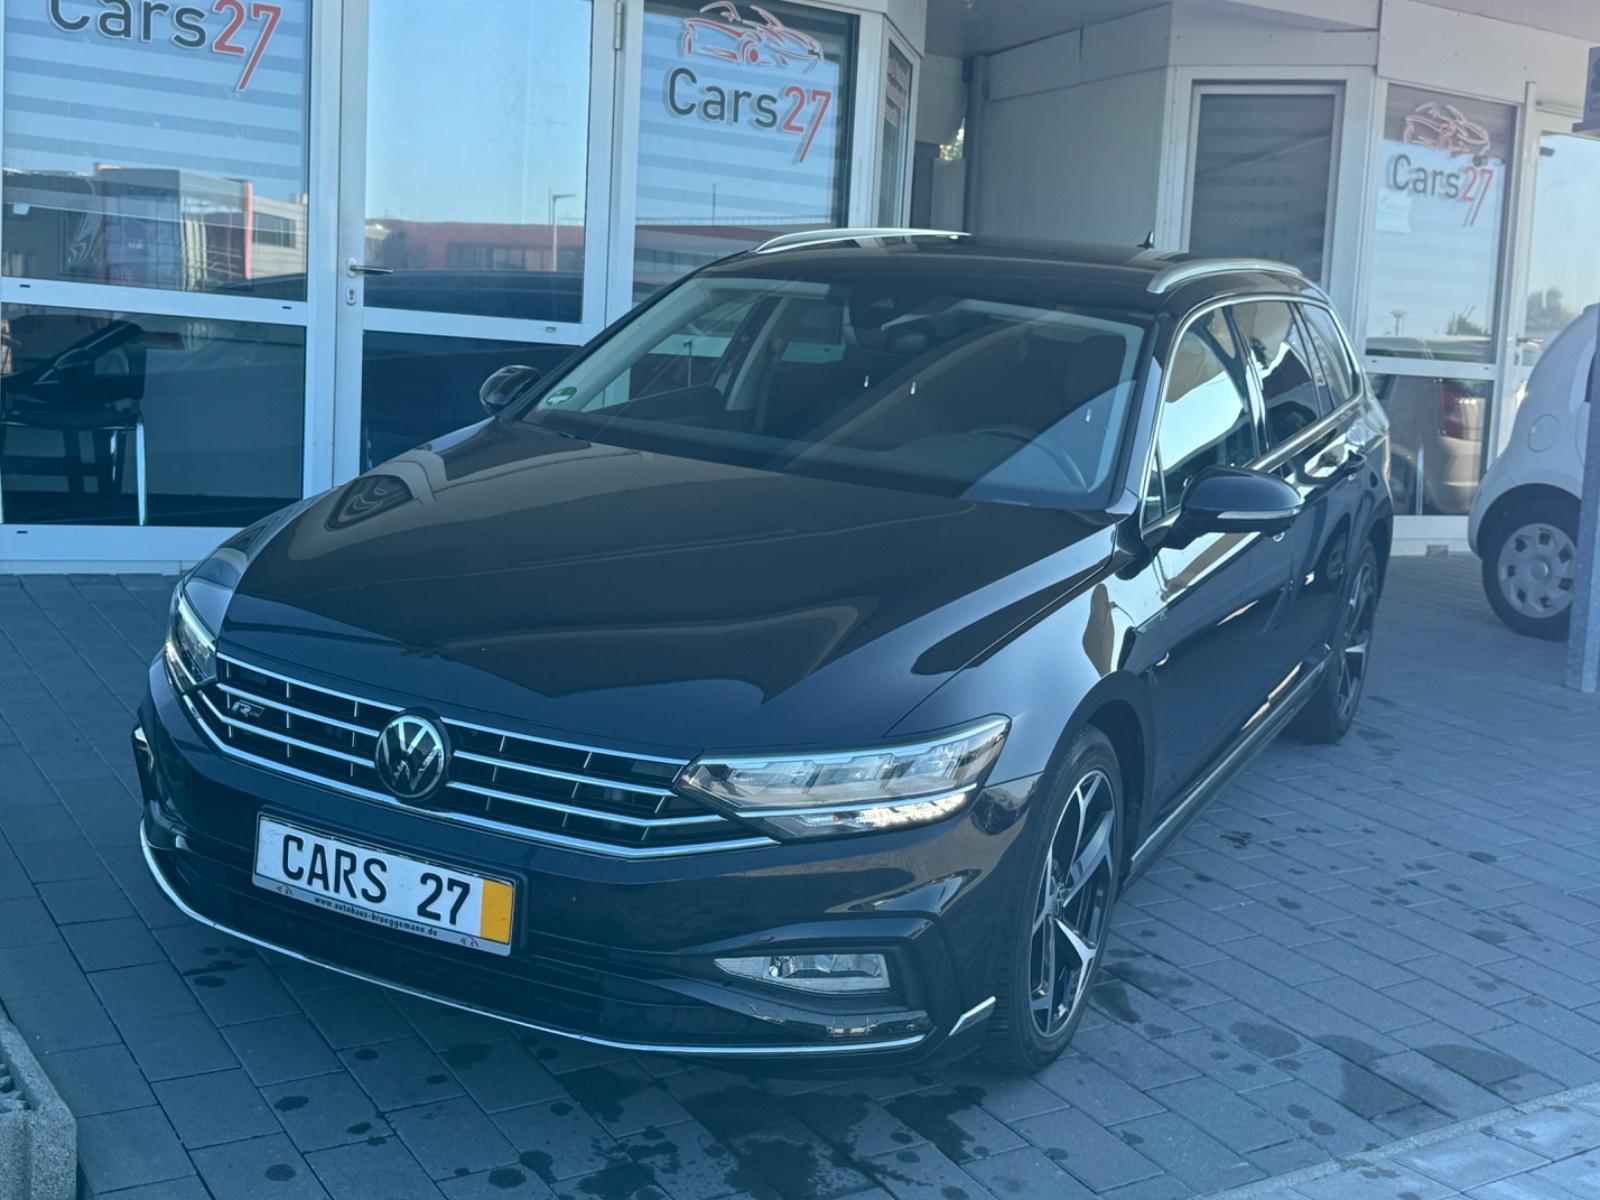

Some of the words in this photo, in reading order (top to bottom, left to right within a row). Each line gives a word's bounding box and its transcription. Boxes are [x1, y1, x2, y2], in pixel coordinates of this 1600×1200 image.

[50, 0, 282, 92] Cars27
[667, 66, 833, 164] Cars27
[1393, 153, 1494, 227] Cars27
[282, 834, 388, 904] CARS
[416, 872, 471, 926] 27
[314, 896, 438, 937] www.autohaus-brueggemann.de
